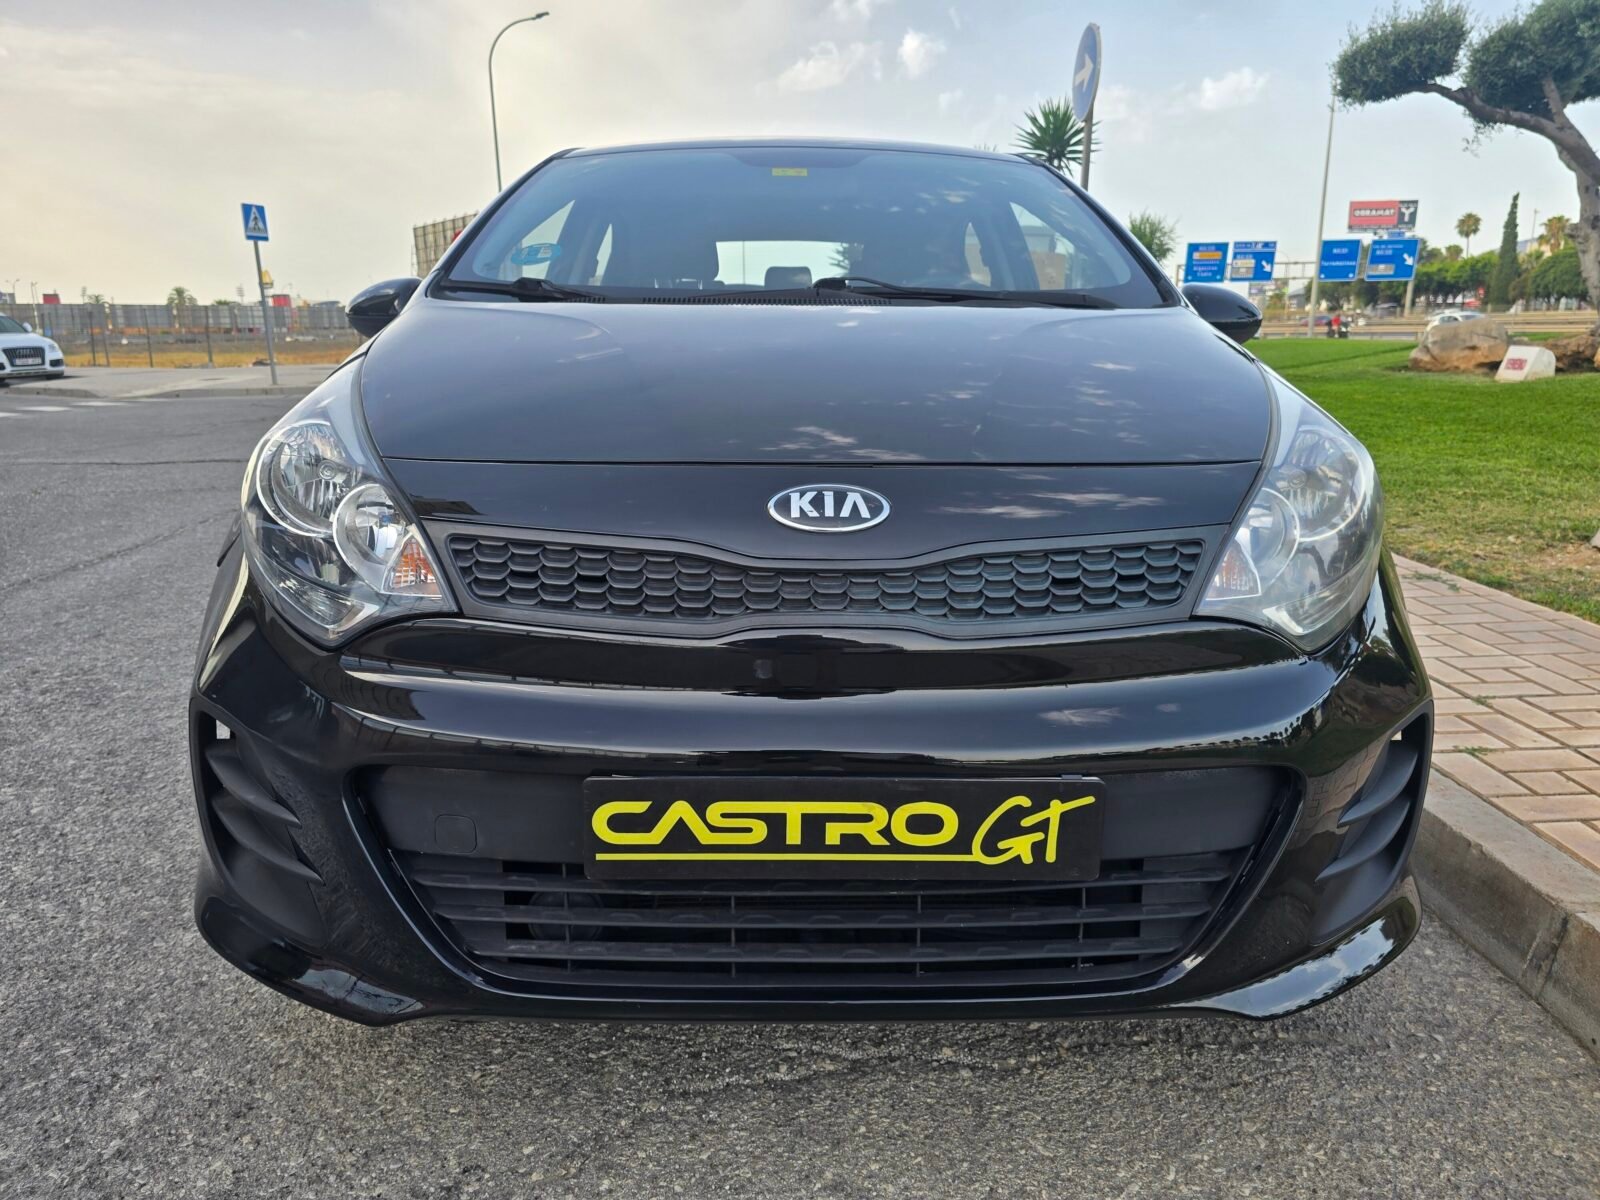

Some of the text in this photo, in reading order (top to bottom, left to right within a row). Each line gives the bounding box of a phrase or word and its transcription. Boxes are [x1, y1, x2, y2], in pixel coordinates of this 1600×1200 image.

[789, 491, 871, 518] KIA
[591, 795, 1096, 865] CASTRO GT
